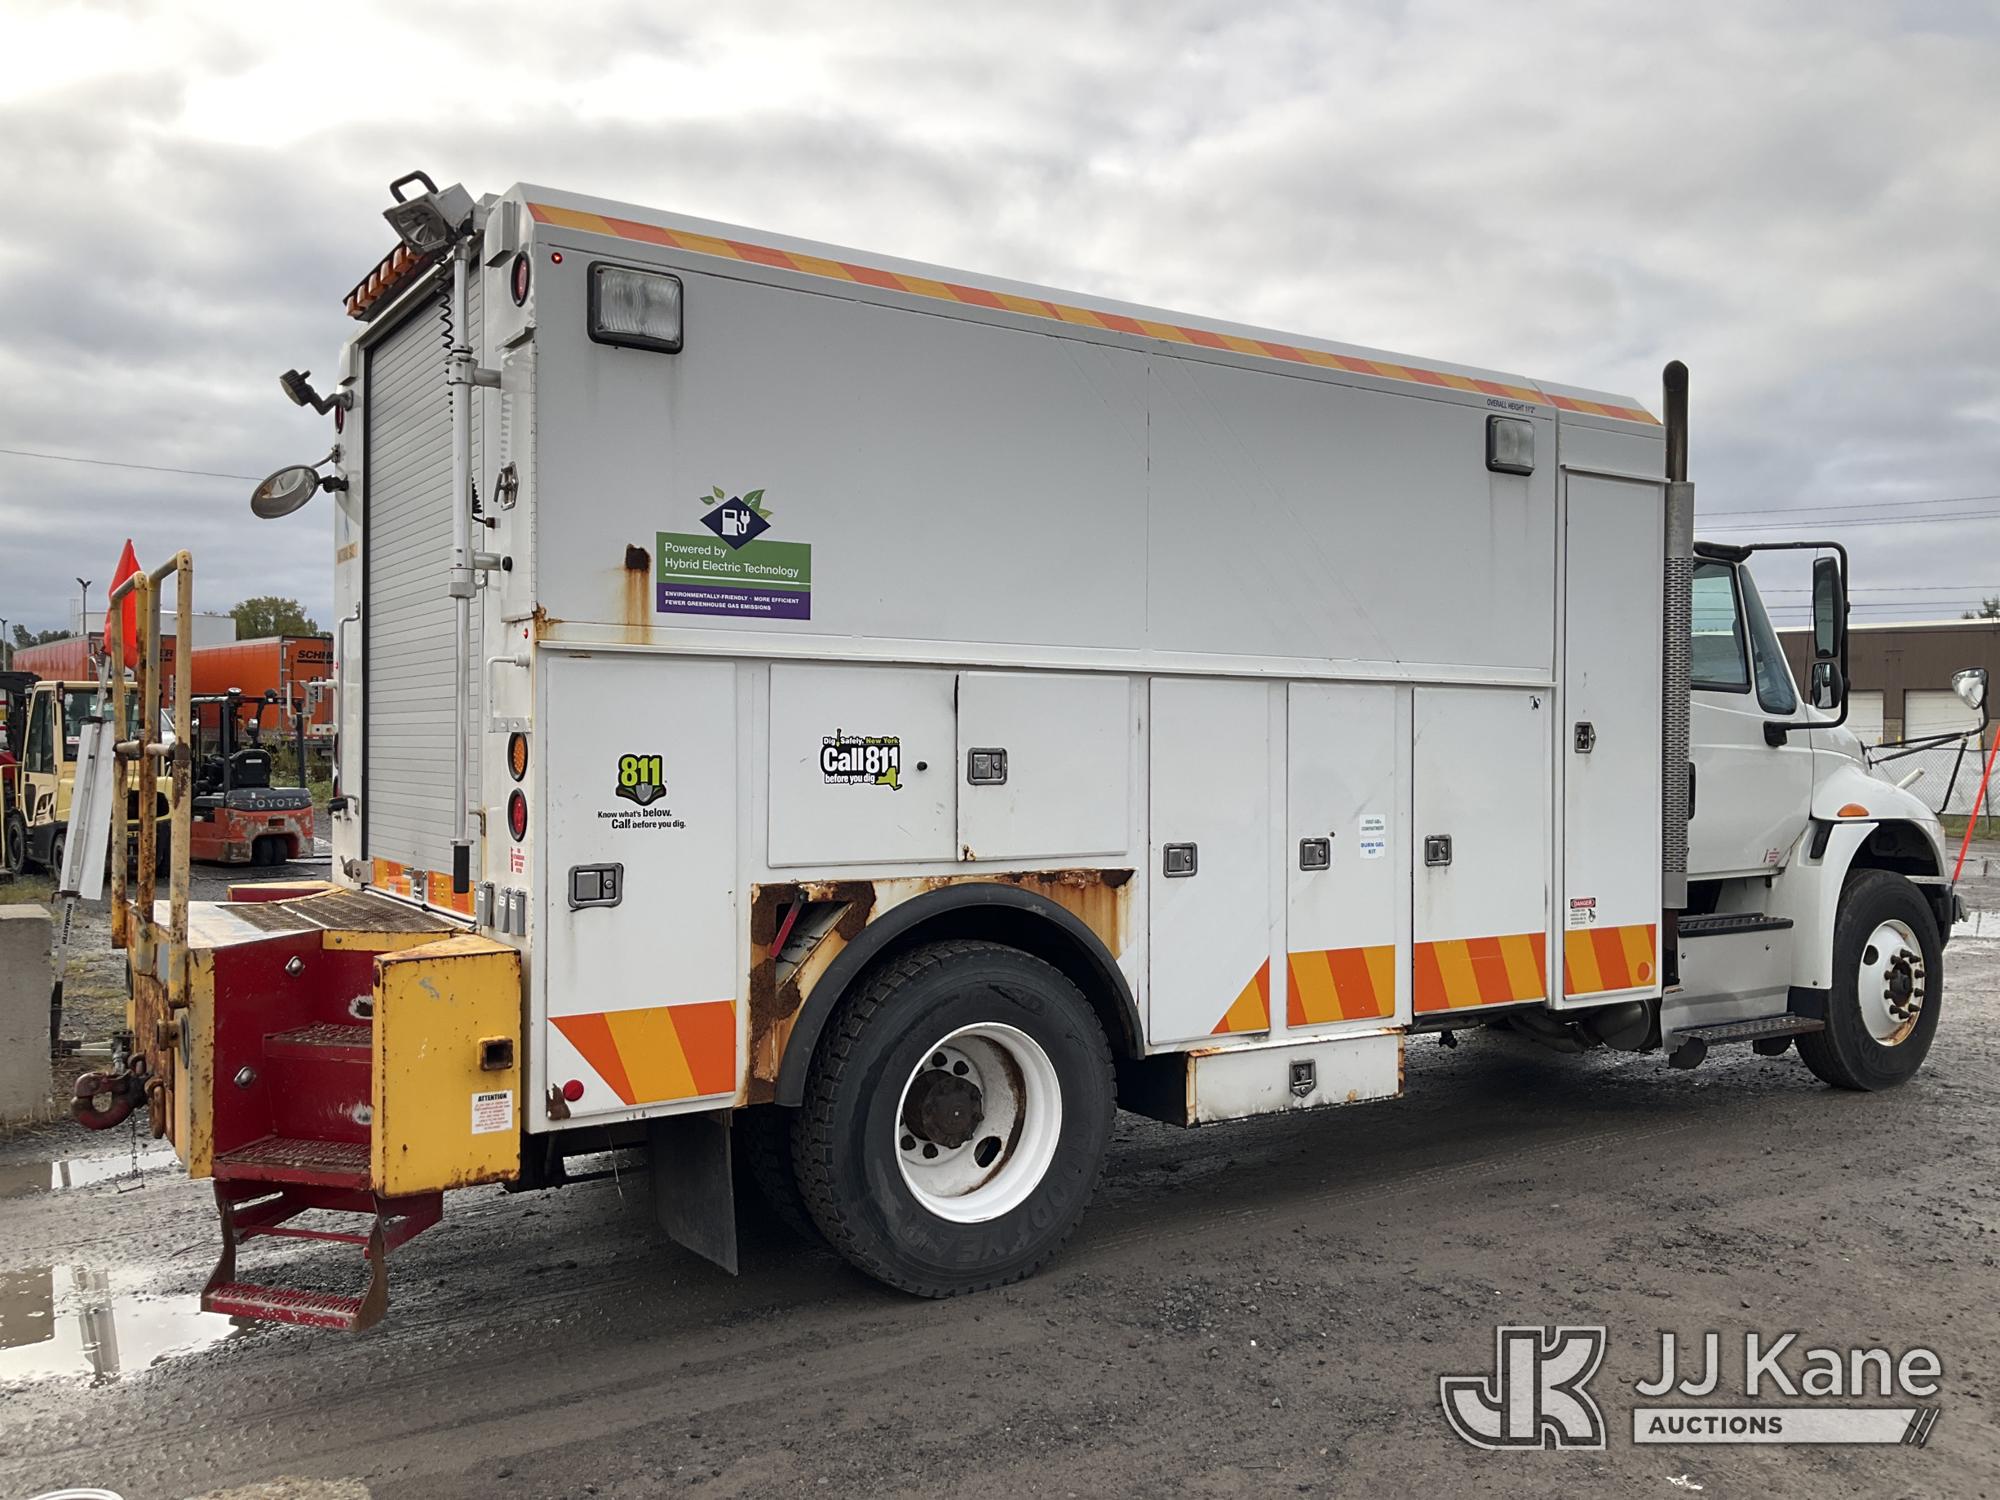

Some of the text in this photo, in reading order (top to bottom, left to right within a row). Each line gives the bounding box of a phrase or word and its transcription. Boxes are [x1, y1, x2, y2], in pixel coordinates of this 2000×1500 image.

[1487, 398, 1507, 409] OVERALL
[665, 542, 727, 559] Powered by
[665, 557, 799, 578] Hybrid Electric Technology
[687, 600, 726, 608] GREENHOUSE
[740, 603, 771, 611] EMISSIONS
[823, 737, 836, 746] Dig
[823, 746, 898, 773] Call 811
[620, 756, 661, 787] 811
[825, 773, 875, 784] before you dig
[248, 798, 302, 809] TOYOTA
[619, 810, 641, 818] what's
[643, 808, 672, 817] below.
[612, 819, 686, 829] Call before you dig.
[478, 1093, 507, 1102] ATTENTION
